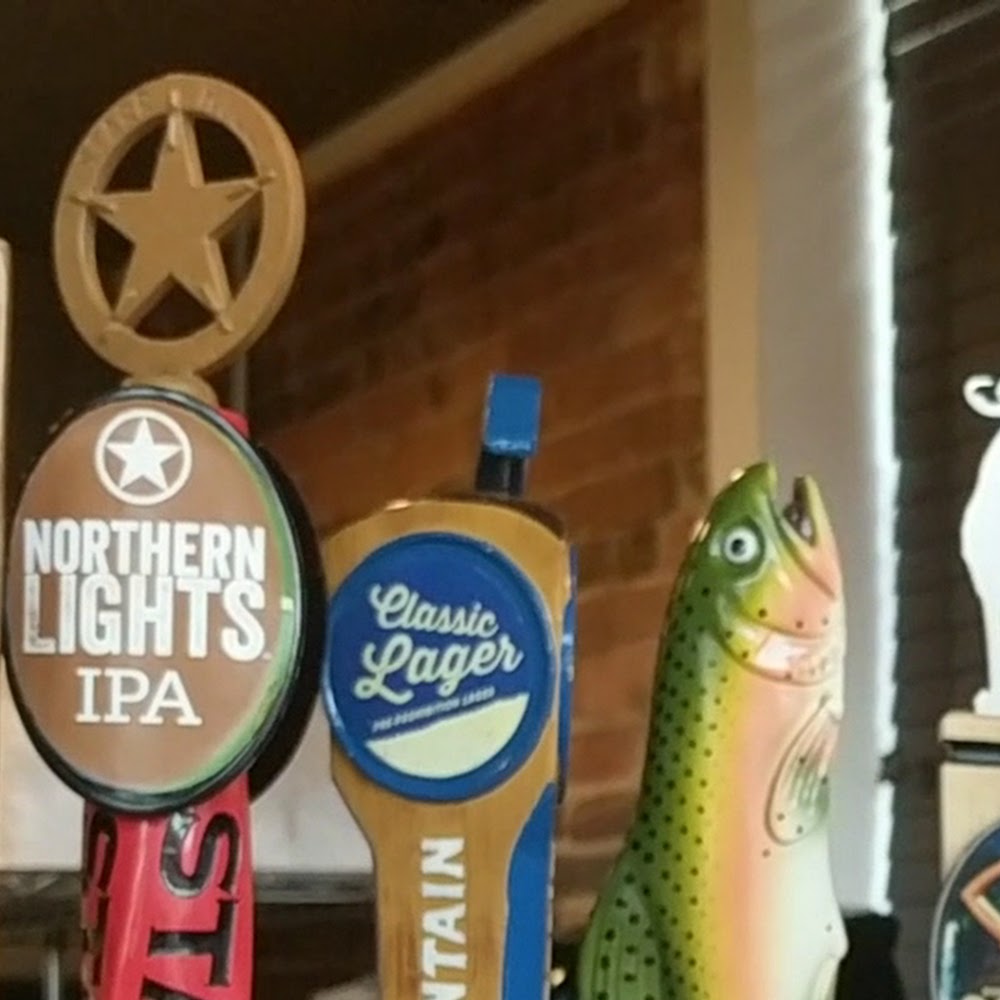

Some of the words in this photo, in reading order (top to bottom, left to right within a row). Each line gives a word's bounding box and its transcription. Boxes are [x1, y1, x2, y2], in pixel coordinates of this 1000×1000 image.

[23, 518, 266, 581] NORTHERN
[23, 573, 266, 661] LIGHTS
[369, 583, 499, 638] Classic
[75, 667, 202, 727] IPA
[354, 633, 524, 705] Lager
